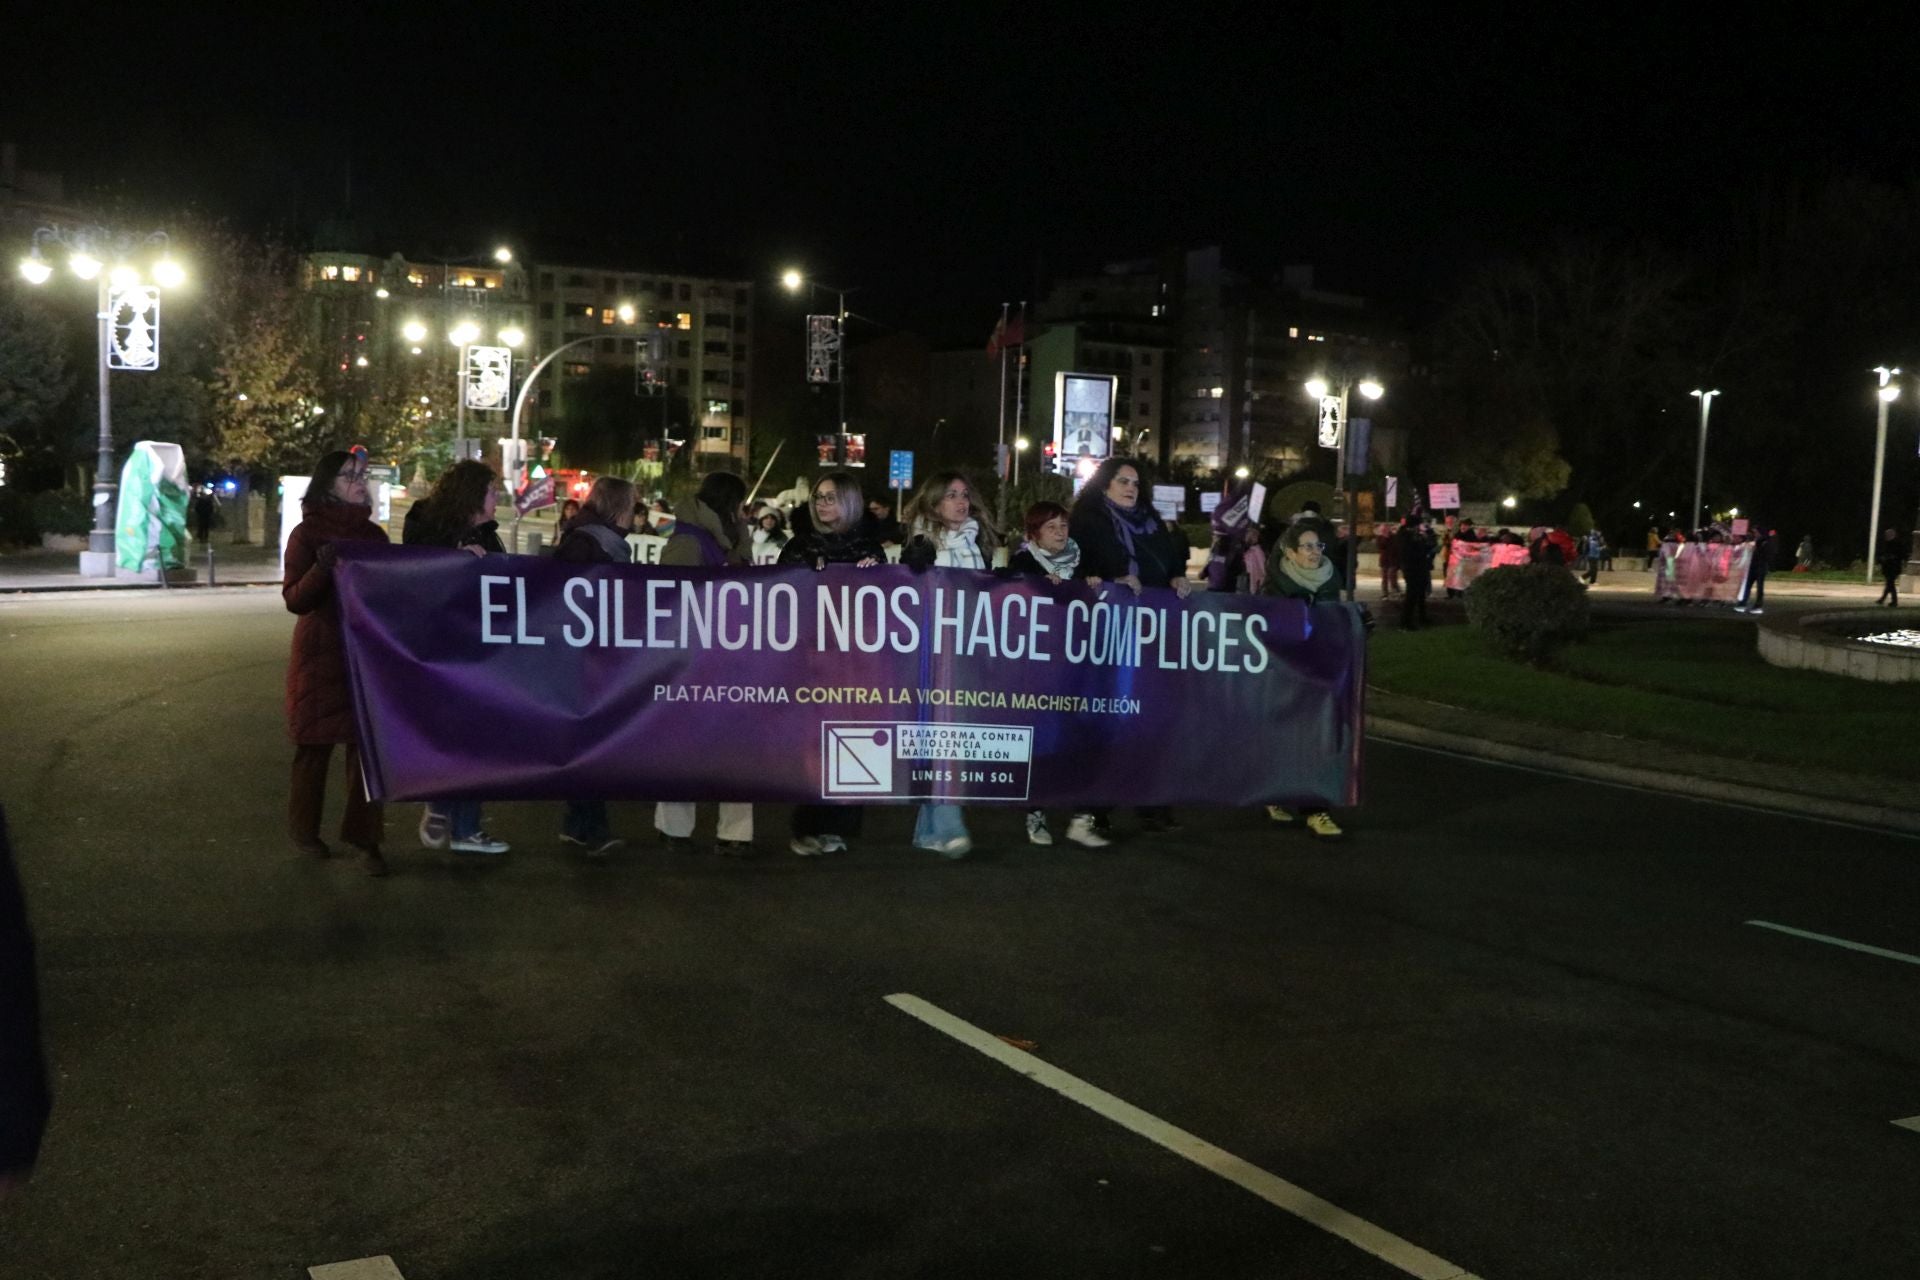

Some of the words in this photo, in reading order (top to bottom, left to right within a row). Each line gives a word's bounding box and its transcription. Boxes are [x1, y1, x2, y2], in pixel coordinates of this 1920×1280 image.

[481, 574, 545, 645] EL
[563, 577, 798, 651] SILENCIO
[817, 585, 920, 653] NOS
[933, 588, 1054, 661] HACE
[1065, 591, 1269, 673] CÓMPLICES
[654, 685, 790, 703] PLATAFORMA
[795, 687, 883, 704] CONTRA
[888, 687, 912, 704] LA
[916, 688, 1007, 708] VIOLENCIA
[1011, 693, 1089, 712] MACHISTA
[1092, 698, 1106, 713] DE
[1108, 695, 1141, 714] LEÓN
[901, 729, 976, 740] PLATAFORMA
[981, 731, 1025, 742] CONTRA
[901, 739, 916, 748] LA
[920, 739, 981, 749] VIOLENCIA
[901, 748, 958, 758] MACHISTA
[964, 750, 977, 759] DE
[982, 748, 1010, 759] LEÓN
[911, 769, 952, 782] LUNES
[960, 771, 984, 783] SIN
[990, 771, 1015, 783] SOL
